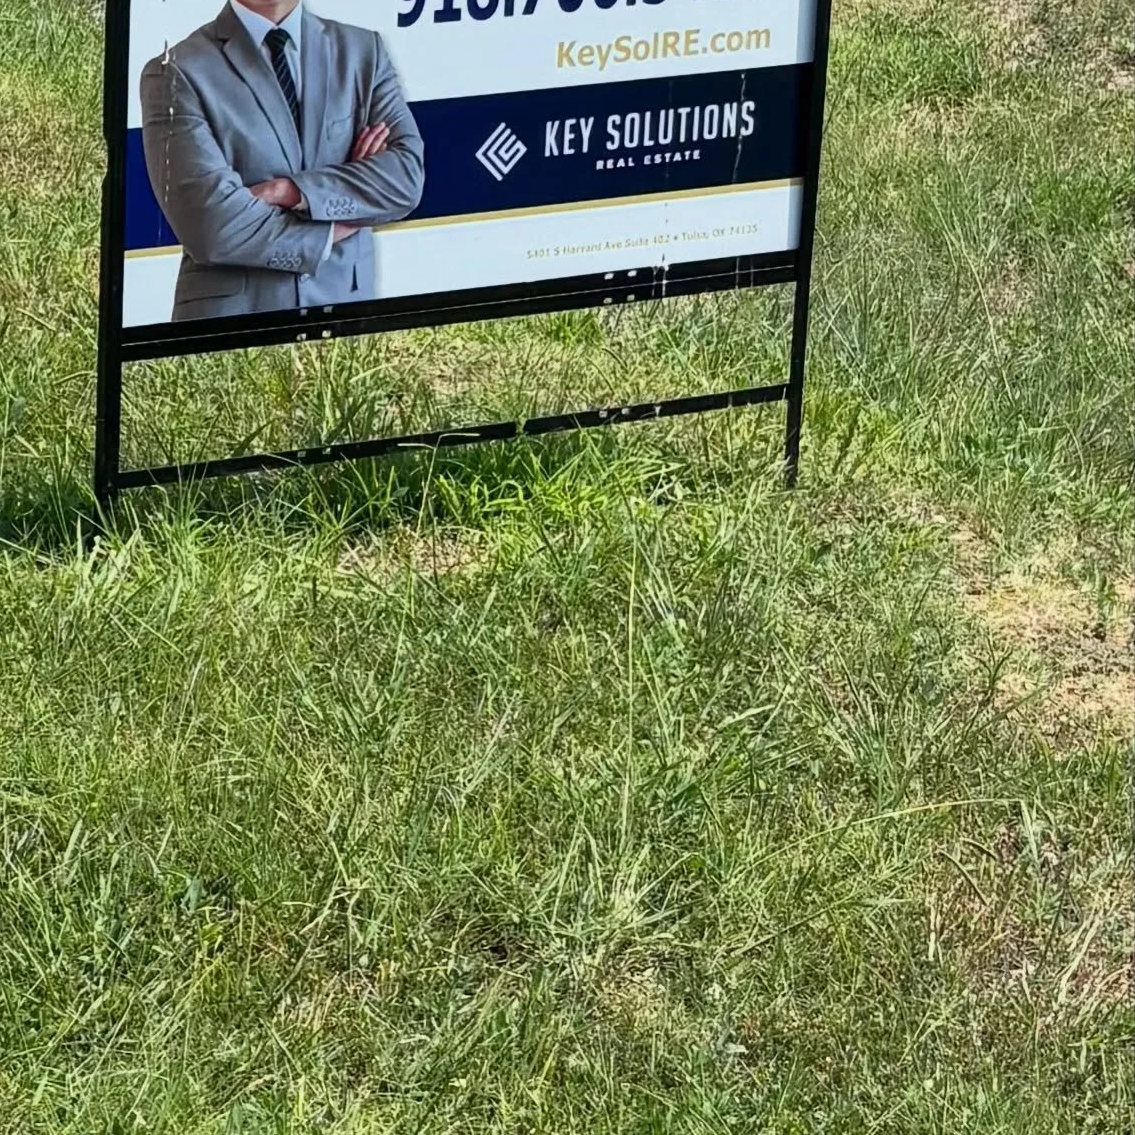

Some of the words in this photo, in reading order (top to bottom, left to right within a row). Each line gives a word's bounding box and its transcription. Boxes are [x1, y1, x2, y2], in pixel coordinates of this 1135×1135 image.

[555, 27, 771, 70] KeySolRE.com
[543, 116, 595, 157] KEY
[605, 100, 755, 150] SOLUTIONS
[595, 156, 635, 170] REAL
[643, 149, 701, 165] ESTATE
[604, 240, 623, 250] Ave
